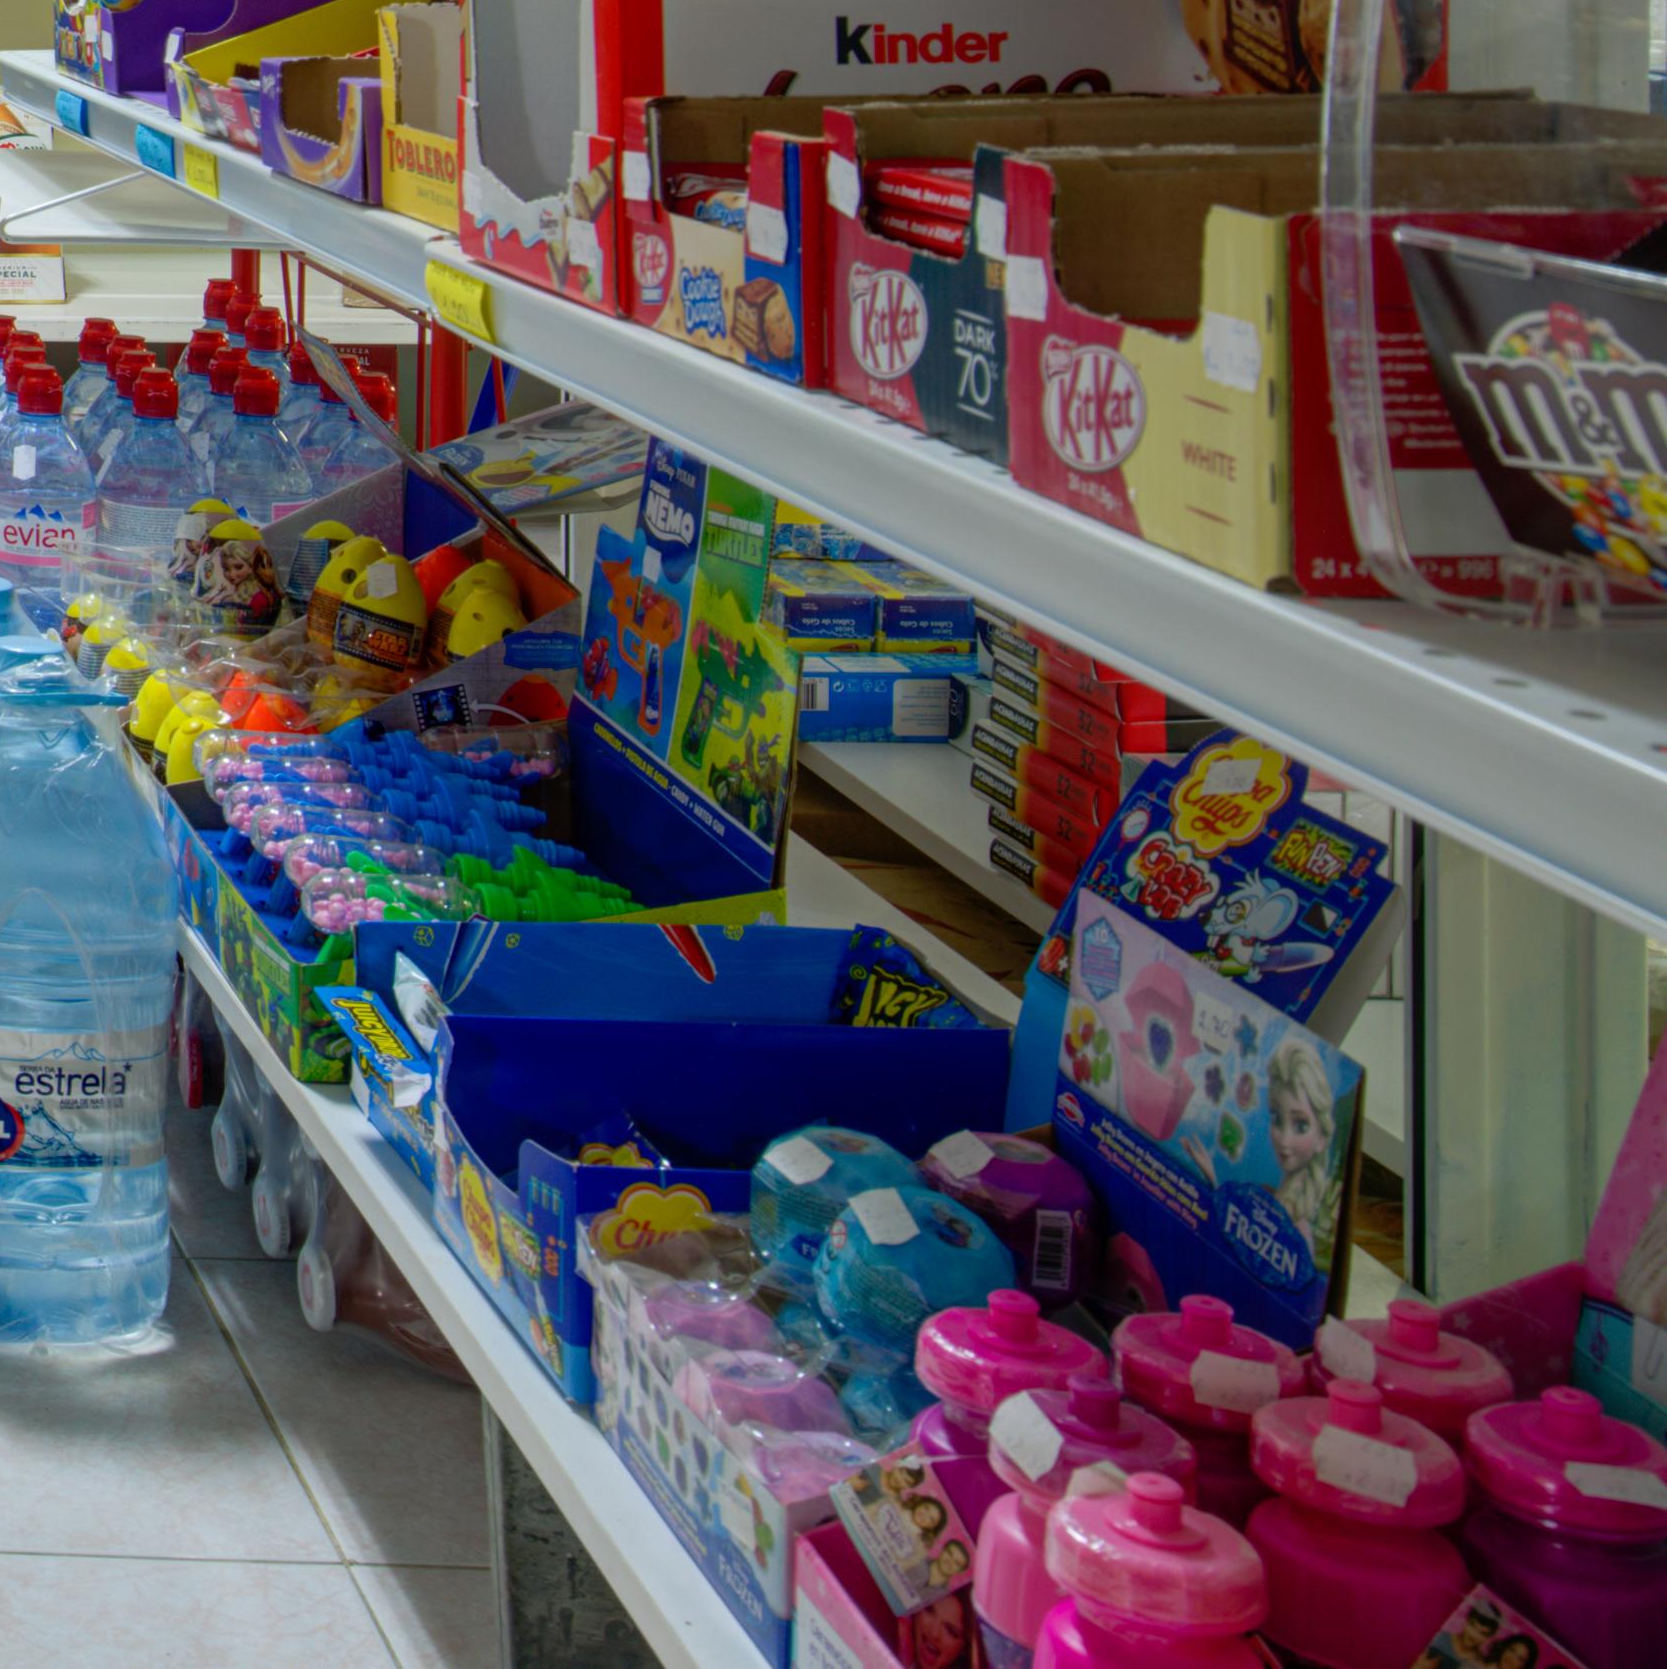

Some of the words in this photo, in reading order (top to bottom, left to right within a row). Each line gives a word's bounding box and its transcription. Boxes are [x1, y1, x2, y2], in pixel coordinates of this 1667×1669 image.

[835, 16, 1008, 64] kinder
[679, 268, 720, 306] Cookie
[683, 298, 724, 336] Dough
[861, 292, 923, 368] KitKat
[954, 316, 996, 352] DARK
[1056, 360, 1135, 456] KitKat
[1182, 440, 1237, 483] WHITE
[3, 522, 76, 549] evian
[644, 489, 696, 546] NEMO
[705, 527, 765, 565] TURTLES
[1279, 832, 1311, 864] FUN
[1139, 837, 1213, 903] CRAZY
[1141, 879, 1184, 920] LAB
[14, 1066, 127, 1098] estrela
[1224, 1202, 1299, 1281] FROZEN
